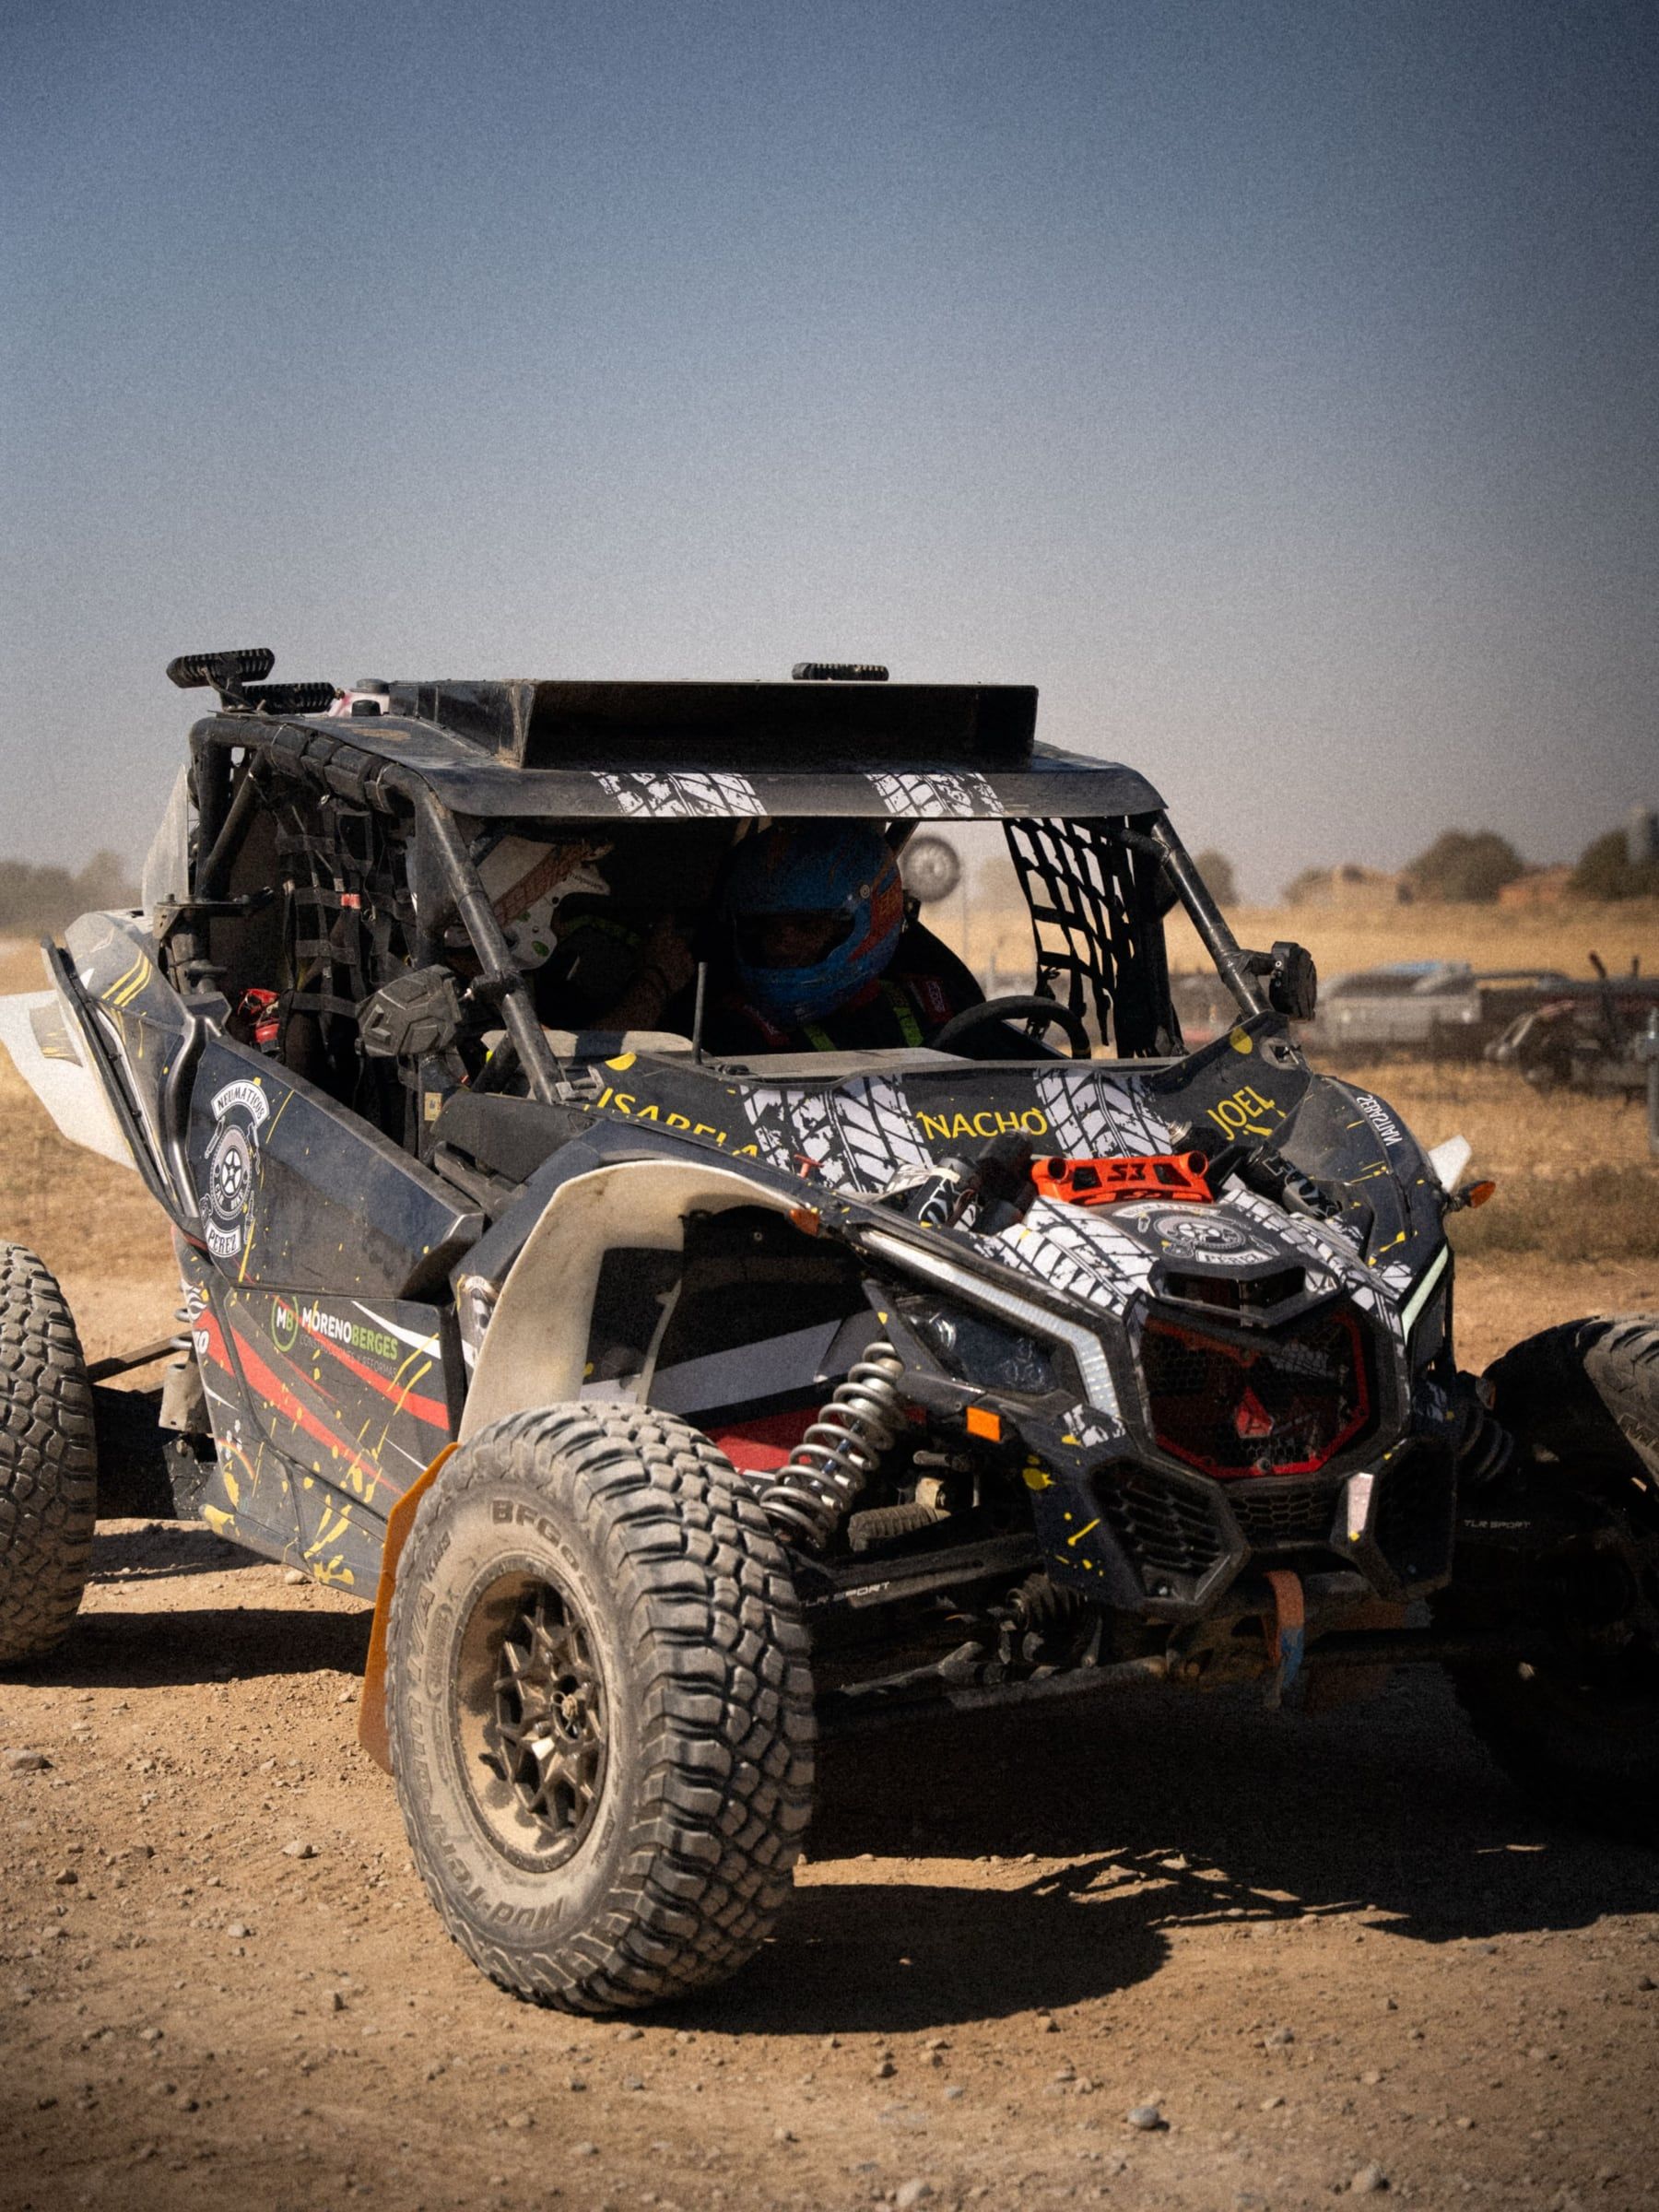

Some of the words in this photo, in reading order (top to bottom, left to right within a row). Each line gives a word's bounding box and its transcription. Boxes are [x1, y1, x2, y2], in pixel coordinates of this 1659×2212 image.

[218, 1085, 266, 1121] NEUMATICOS
[1206, 1086, 1276, 1141] JOEL
[918, 1109, 1048, 1141] NACHO
[207, 1230, 238, 1254] PEREZ
[276, 1306, 295, 1331] MB
